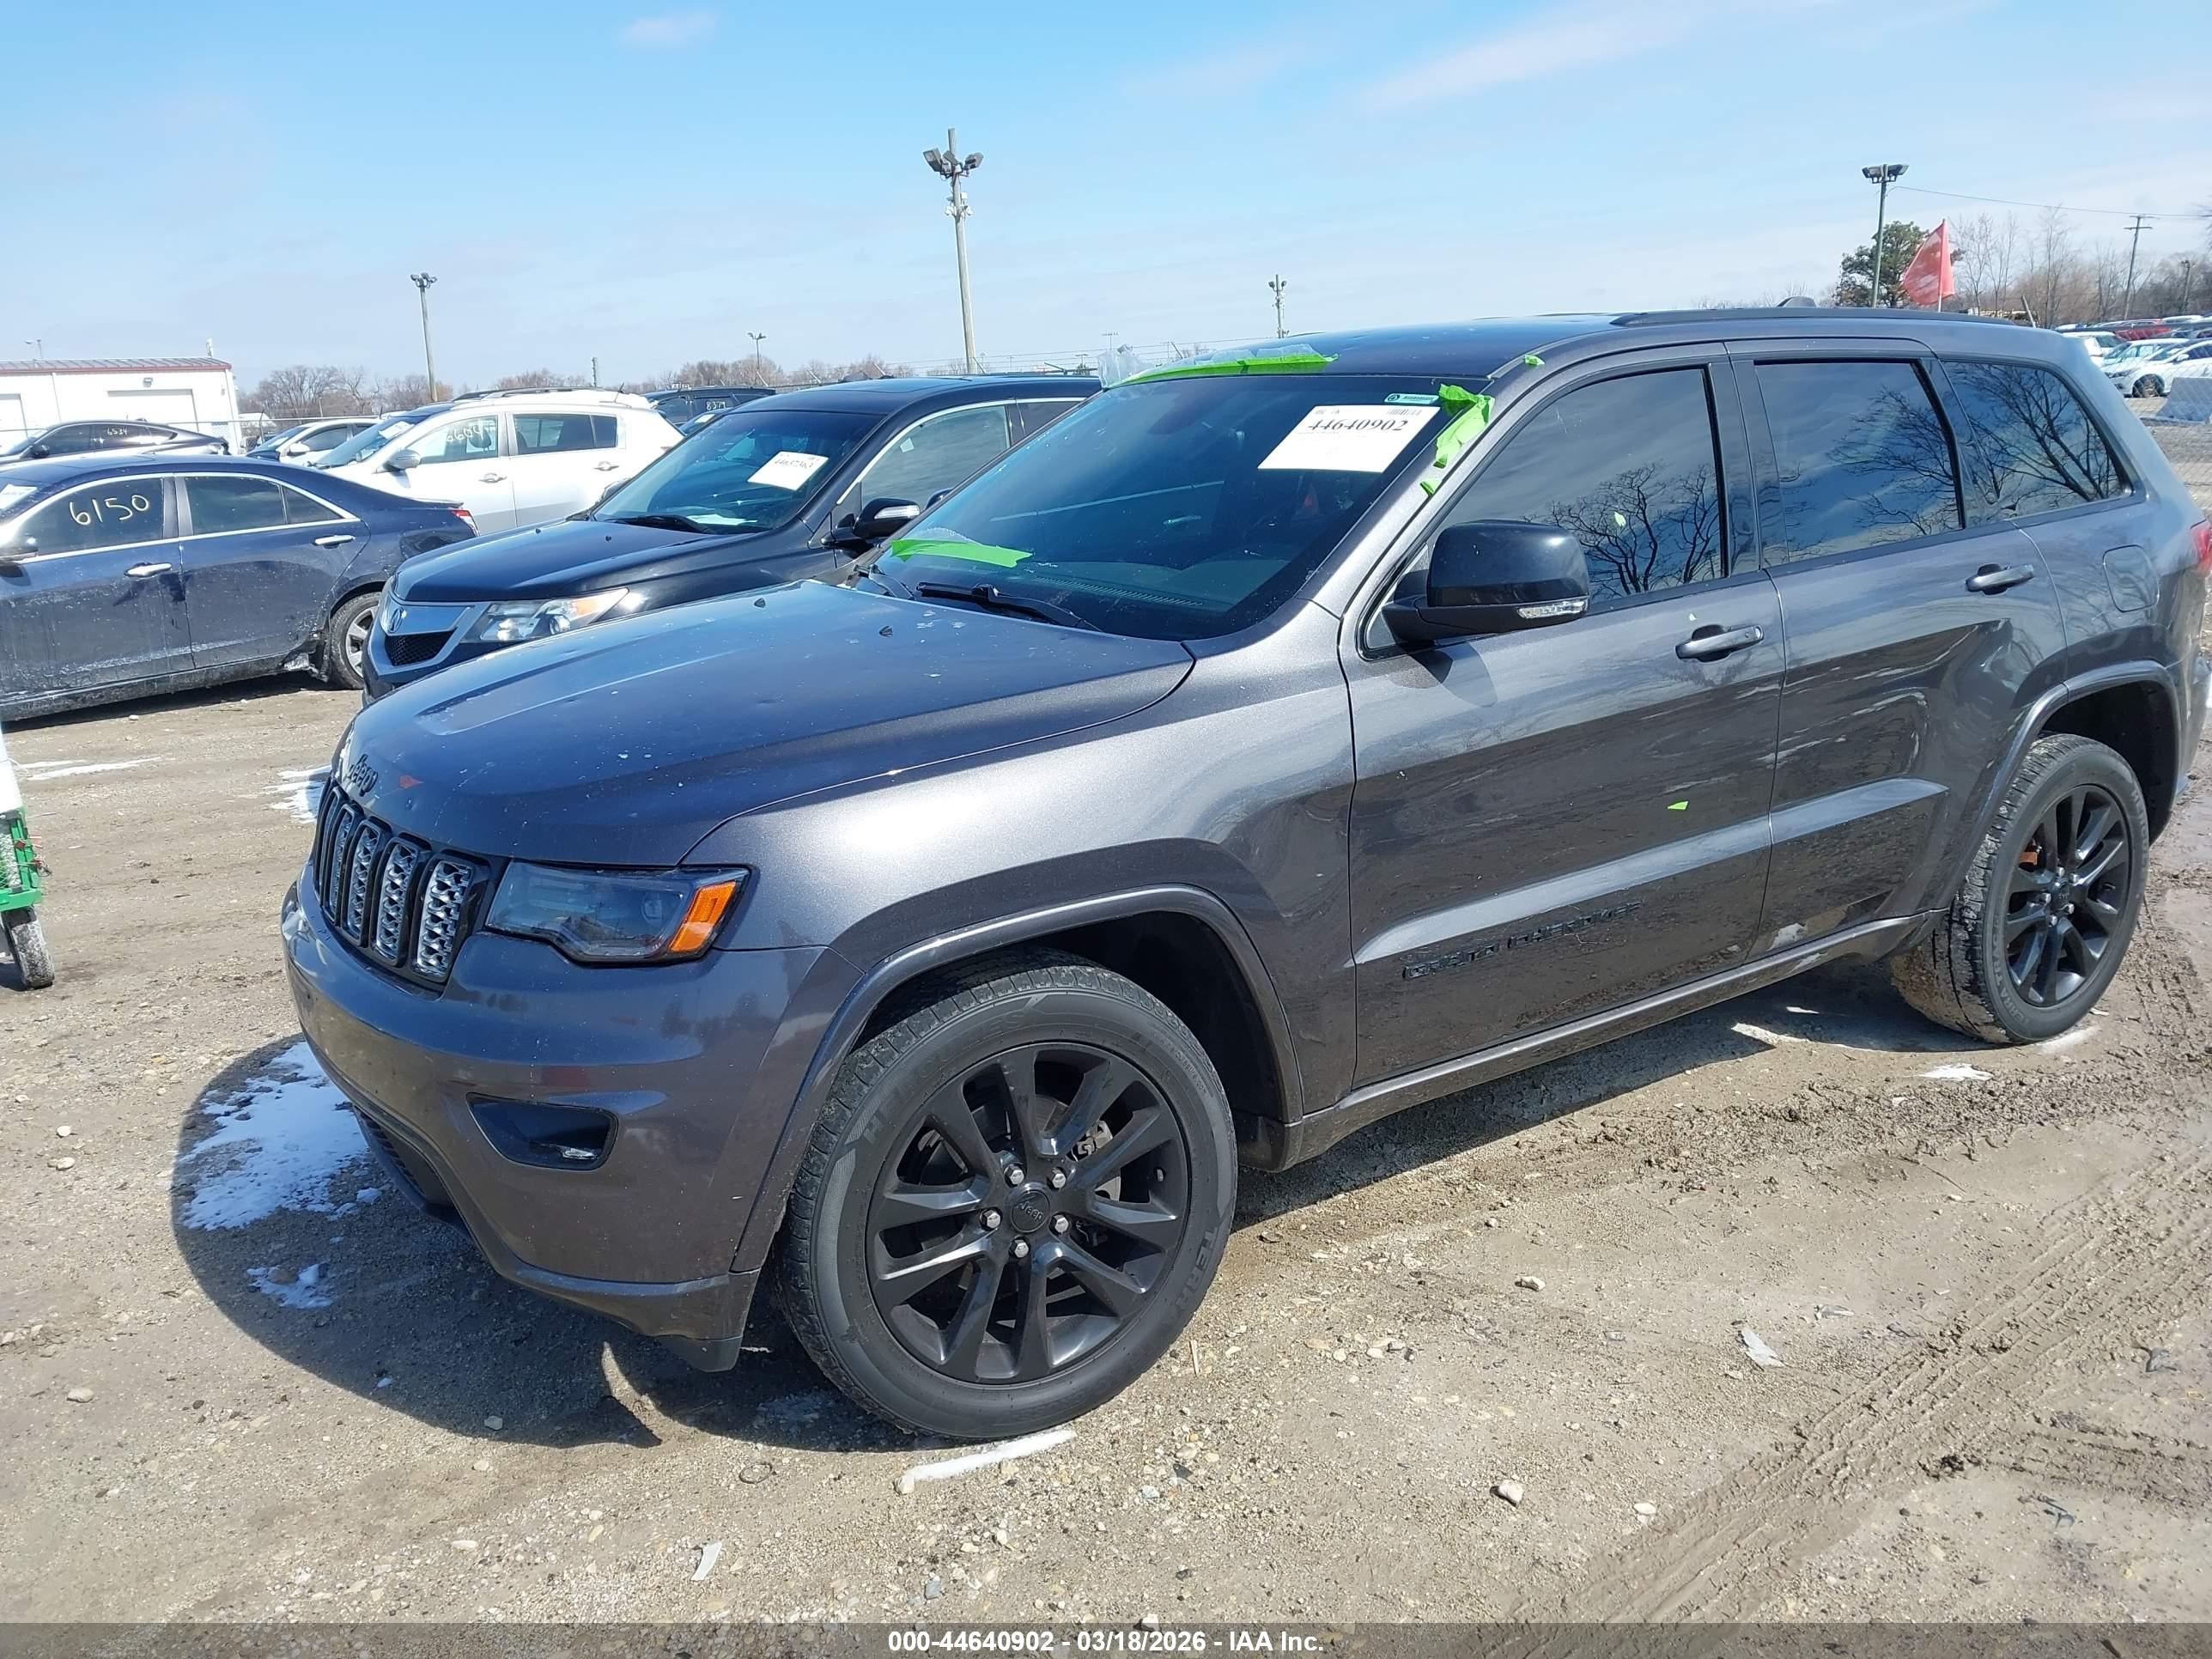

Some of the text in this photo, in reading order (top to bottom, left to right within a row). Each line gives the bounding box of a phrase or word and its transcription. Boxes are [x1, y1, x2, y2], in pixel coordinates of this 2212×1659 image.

[1308, 418, 1409, 431] 44640902
[69, 494, 149, 525] 6150
[349, 753, 379, 797] Jeep
[1018, 1200, 1044, 1223] Jeep
